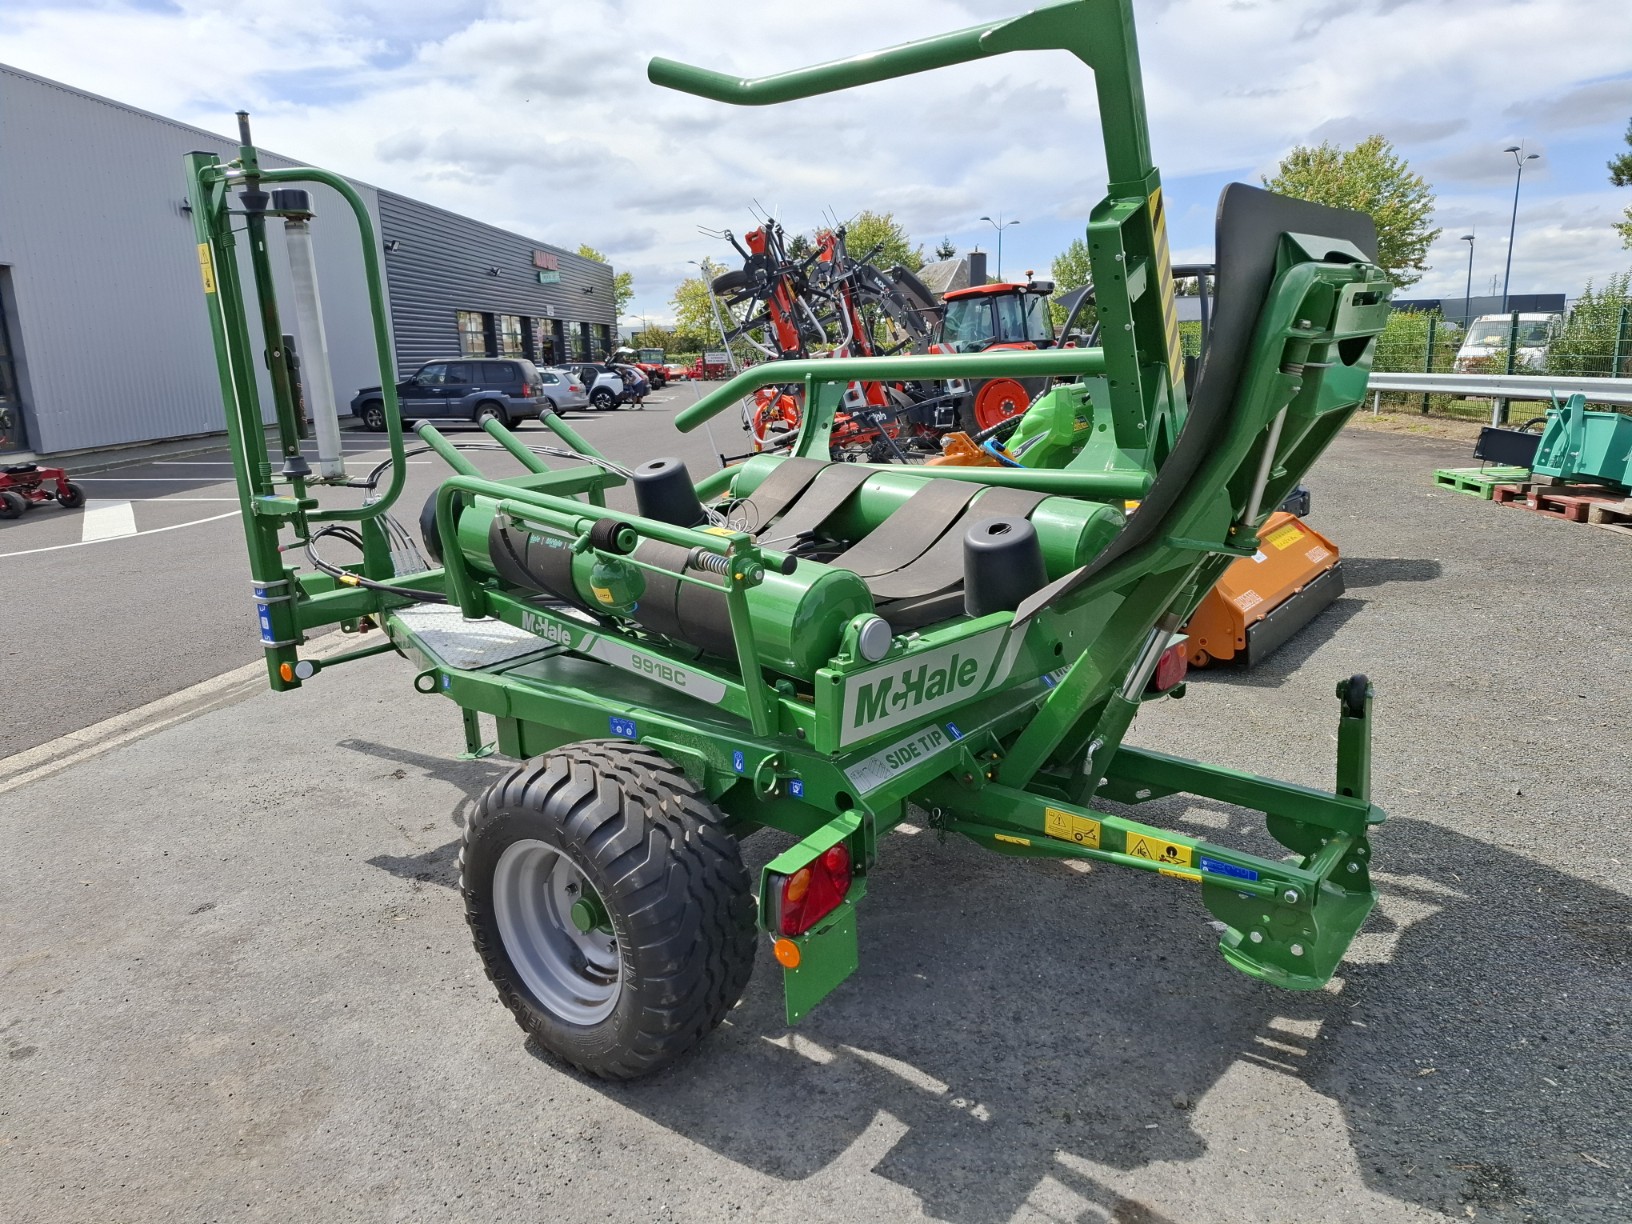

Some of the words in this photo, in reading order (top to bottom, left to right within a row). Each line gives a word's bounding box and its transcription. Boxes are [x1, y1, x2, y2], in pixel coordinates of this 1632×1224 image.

[521, 611, 571, 645] McHale
[853, 653, 978, 729] McHale
[885, 742, 921, 770] SIDE
[918, 730, 943, 753] TIP
